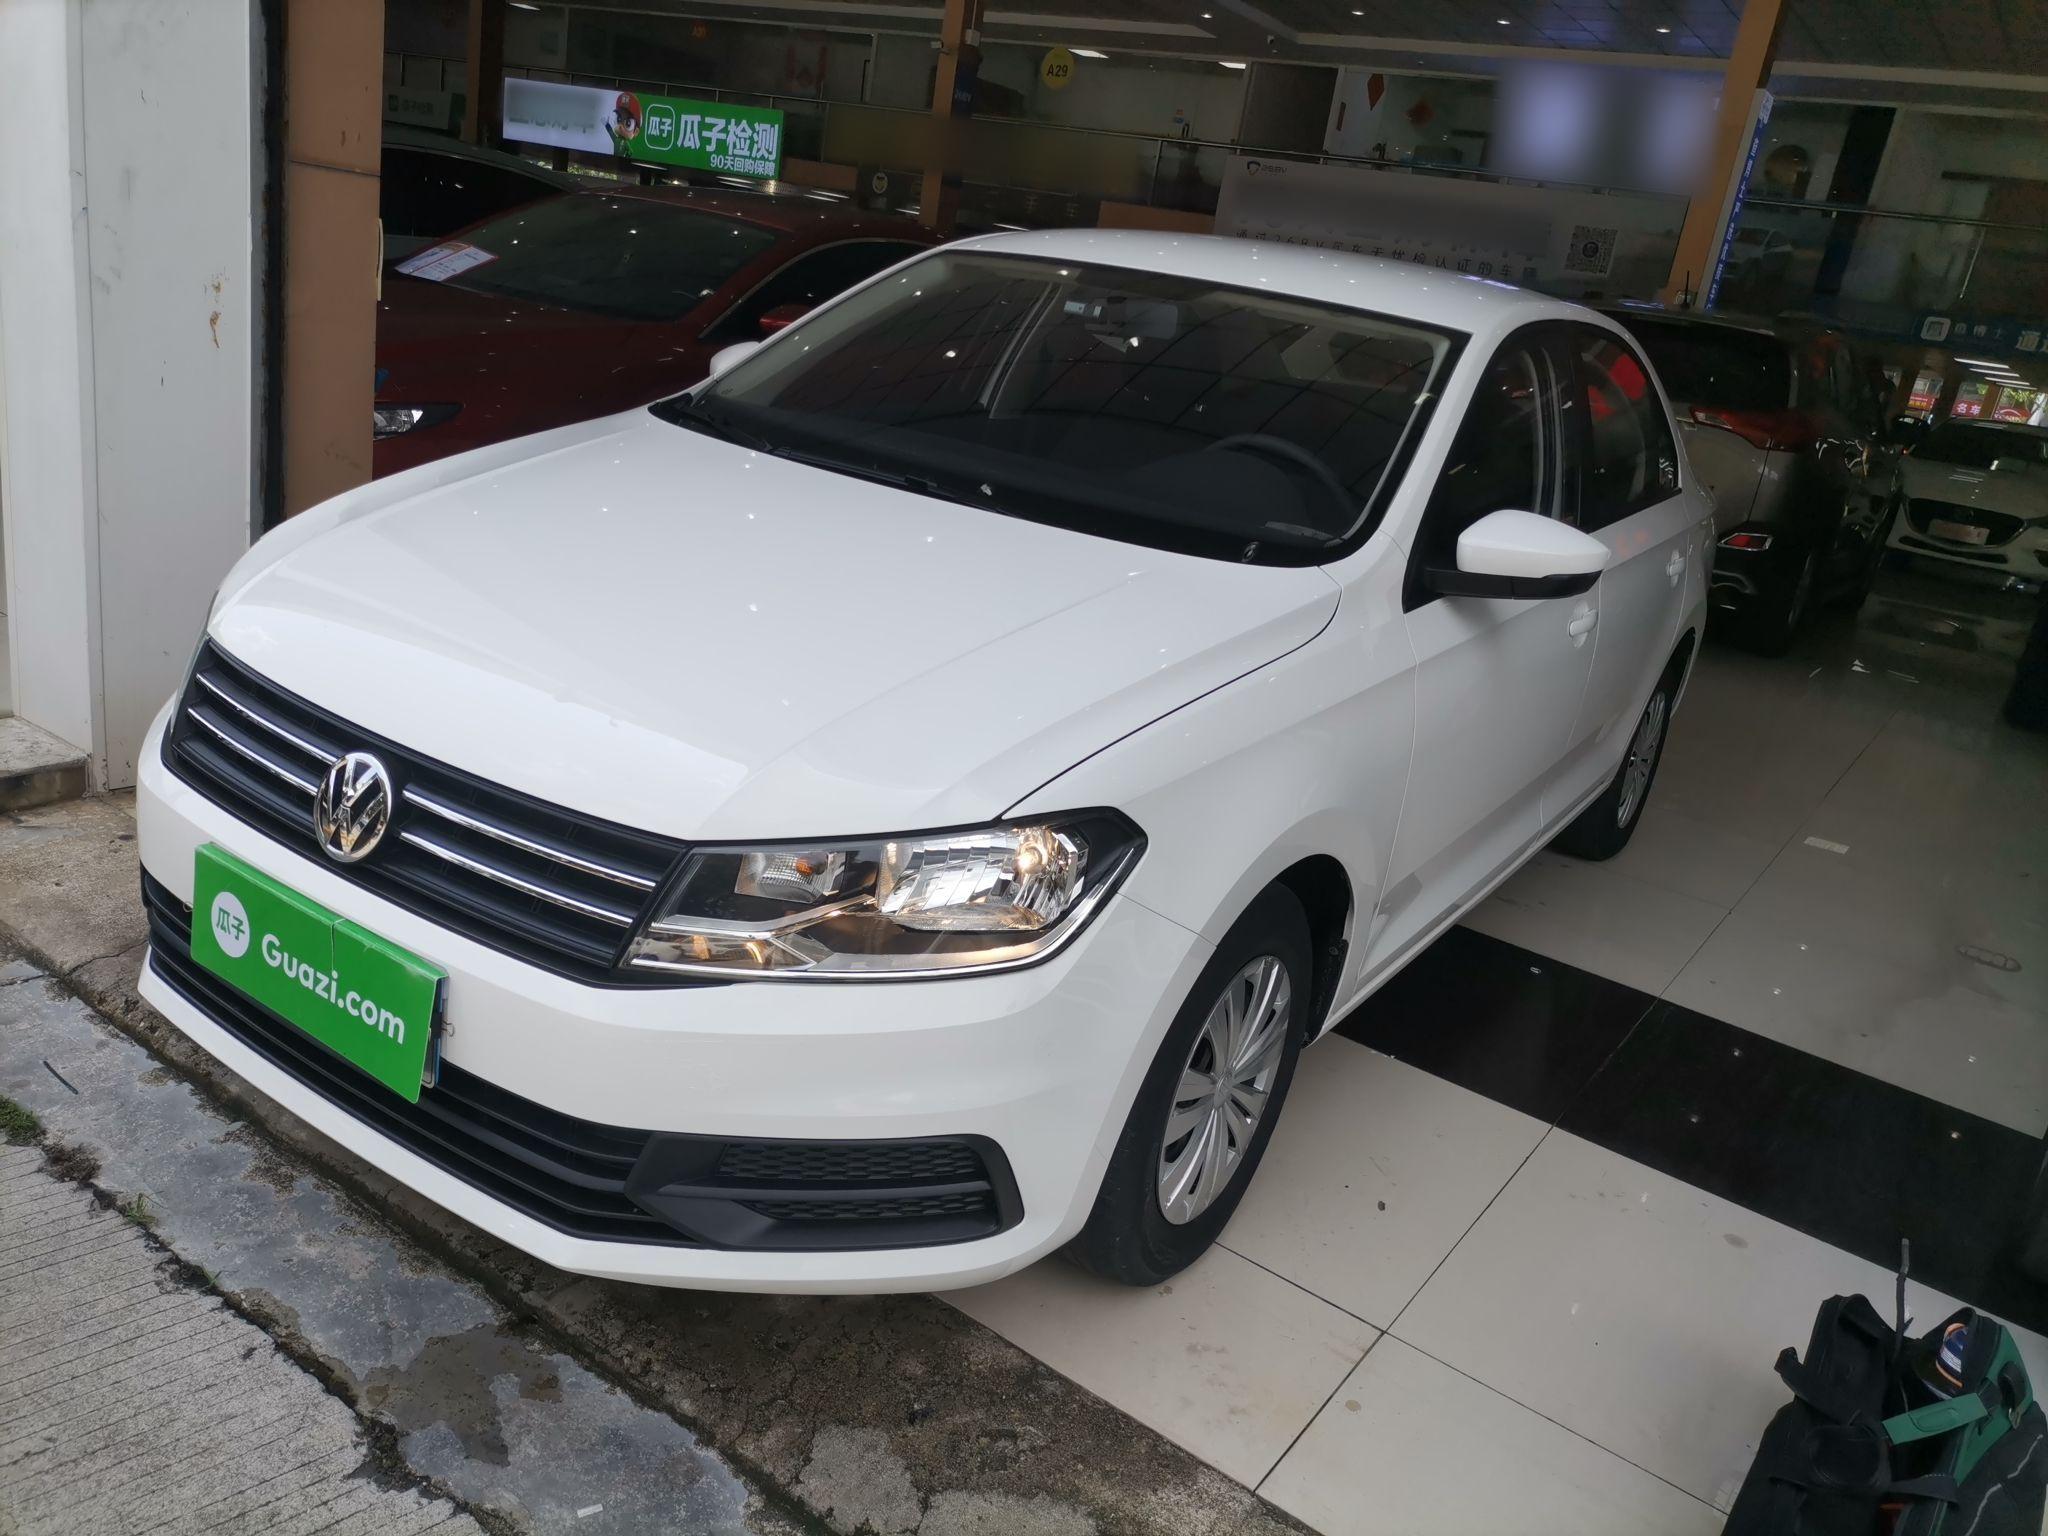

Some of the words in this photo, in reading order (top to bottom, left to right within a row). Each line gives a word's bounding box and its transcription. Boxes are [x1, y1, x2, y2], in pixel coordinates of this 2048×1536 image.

[1046, 63, 1068, 77] A29
[648, 116, 672, 138] 瓜子
[677, 114, 779, 161] 瓜子检测
[710, 153, 775, 177] 90天回购保障
[216, 906, 246, 941] 瓜子
[261, 933, 405, 1045] Guazi.com
